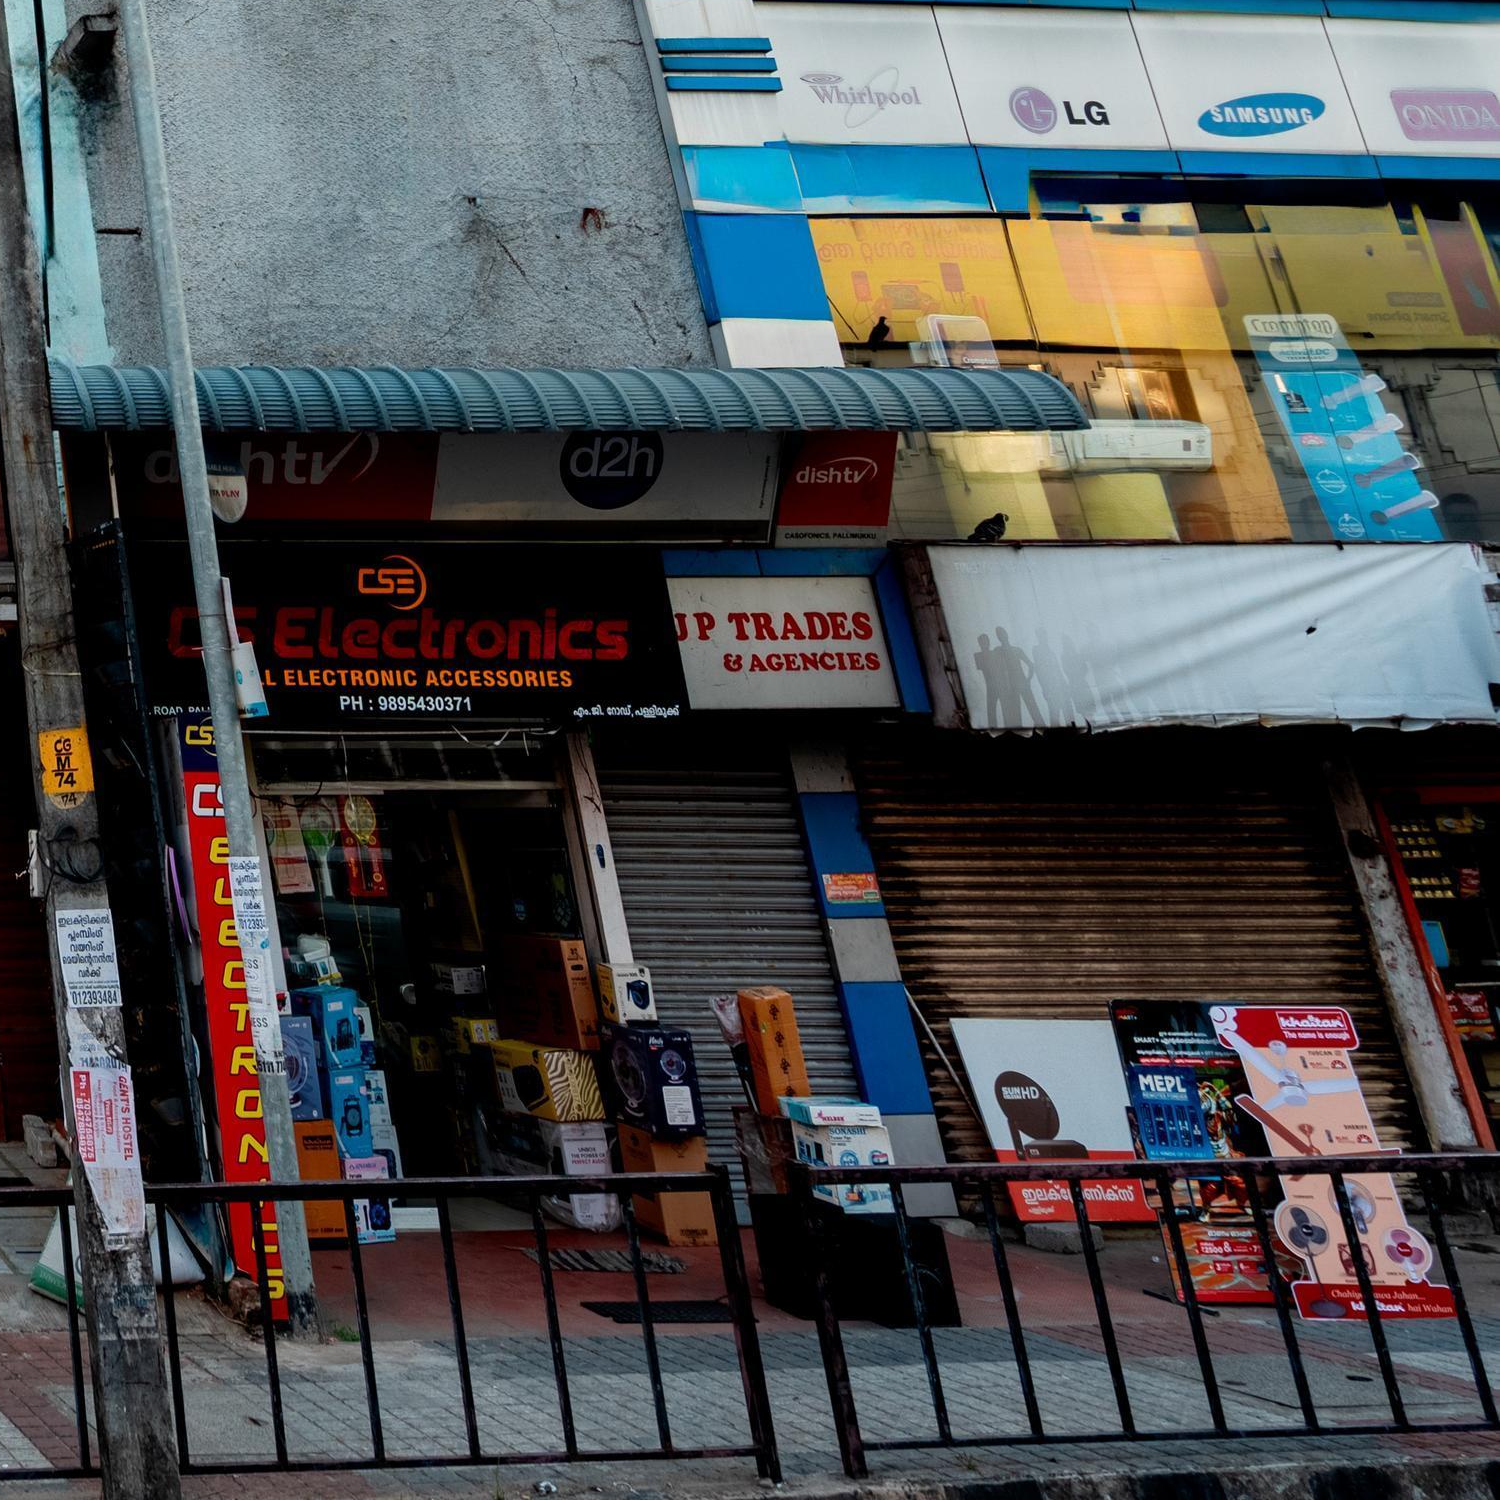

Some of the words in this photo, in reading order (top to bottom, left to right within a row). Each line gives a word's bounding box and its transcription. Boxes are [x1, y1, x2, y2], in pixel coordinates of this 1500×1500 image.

[808, 85, 923, 111] Whirlpool
[1062, 100, 1111, 126] LG
[1210, 104, 1315, 124] SAMSUNG
[1401, 103, 1500, 131] ONIDA
[569, 437, 656, 478] d2h
[795, 462, 872, 485] dishtv
[221, 489, 240, 498] PLAY
[357, 566, 418, 595] CSE
[272, 604, 632, 662] Electronics
[728, 612, 874, 642] TRADES
[723, 652, 744, 672] &
[749, 652, 881, 672] AGENCIES
[284, 668, 418, 688] ELECTRONIC
[425, 668, 573, 688] ACCESSORIES
[340, 695, 365, 712] PH
[377, 695, 472, 713] 9895430371
[54, 737, 72, 754] CG
[56, 755, 71, 769] M
[53, 772, 77, 788] 74
[70, 990, 118, 1006] 012393484
[1279, 1012, 1344, 1030] khaitan
[1283, 1030, 1298, 1041] The
[1298, 1031, 1316, 1041] name
[1316, 1032, 1324, 1041] is
[1325, 1032, 1350, 1043] enough
[79, 1074, 87, 1089] Ph
[1137, 1073, 1188, 1093] MEPL
[118, 1075, 130, 1114] GENT'S
[1002, 1085, 1021, 1095] SUN
[1021, 1086, 1040, 1099] HD
[121, 1117, 134, 1161] HOSTEL
[829, 1126, 867, 1136] SONASHI
[1407, 1303, 1422, 1313] hai
[1422, 1304, 1453, 1314] Wahan
